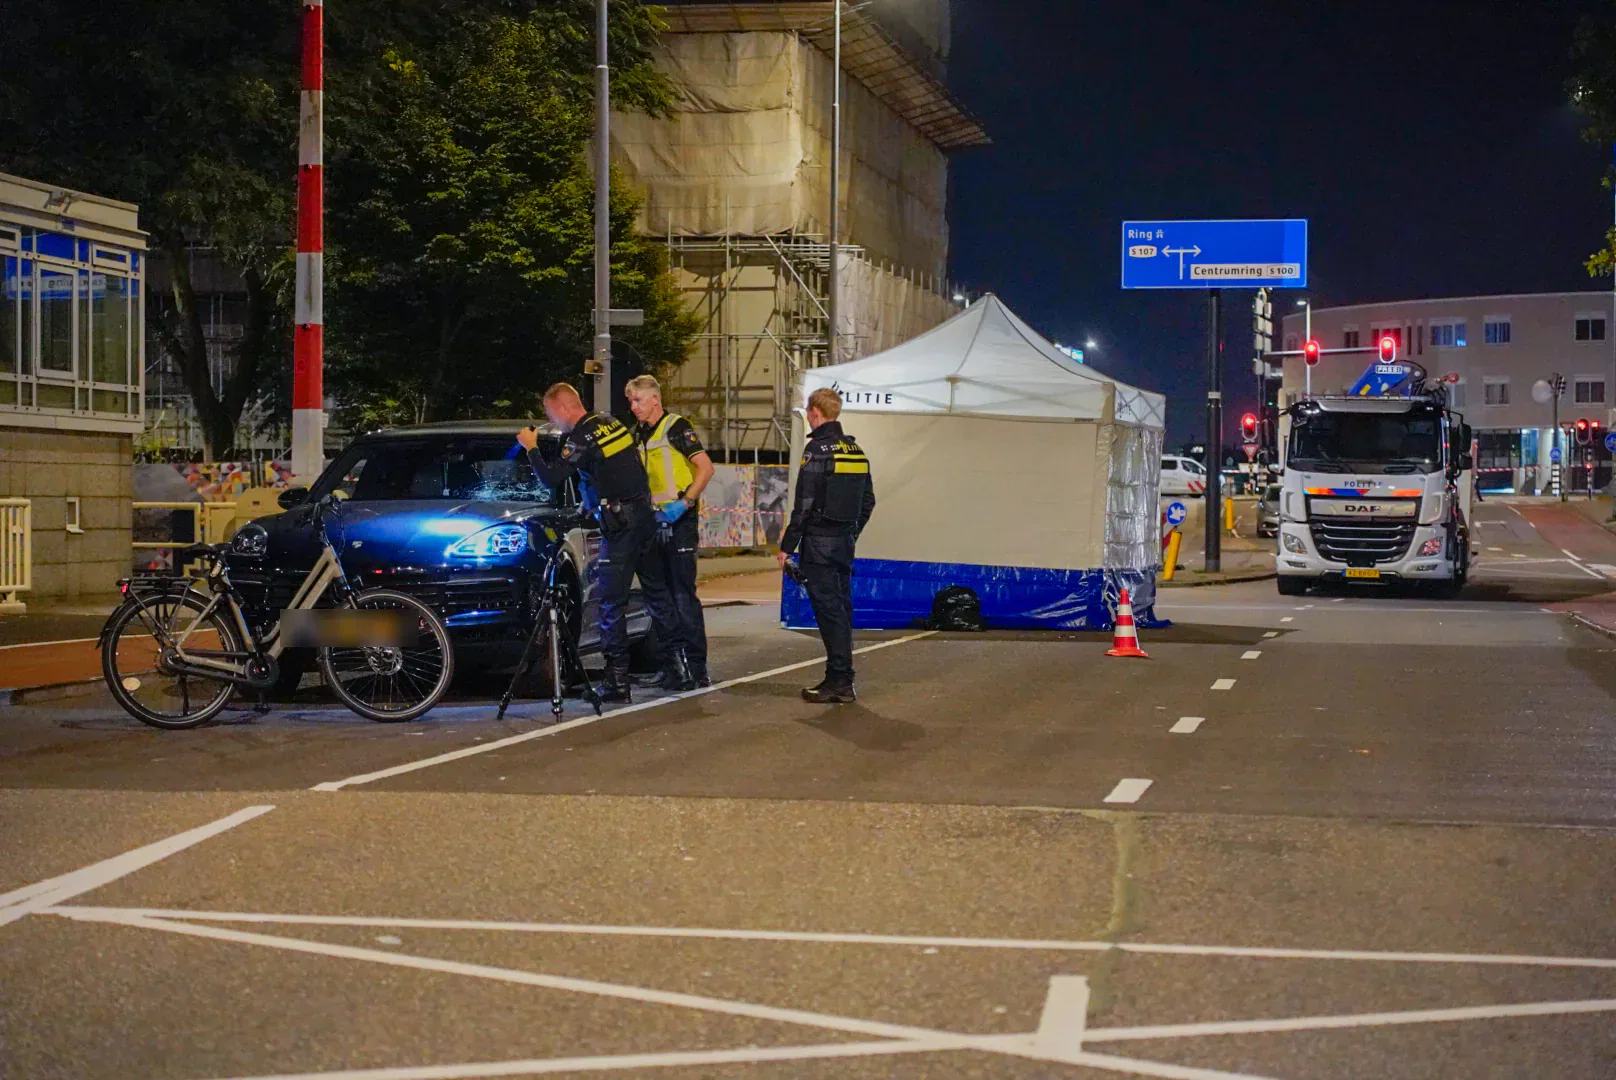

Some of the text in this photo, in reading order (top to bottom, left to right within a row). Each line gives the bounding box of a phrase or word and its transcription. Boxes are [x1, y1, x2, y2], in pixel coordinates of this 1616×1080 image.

[1128, 229, 1153, 241] Ring
[1194, 265, 1263, 277] Centrumring
[846, 391, 893, 405] LITIE
[1345, 505, 1381, 513] DAF
